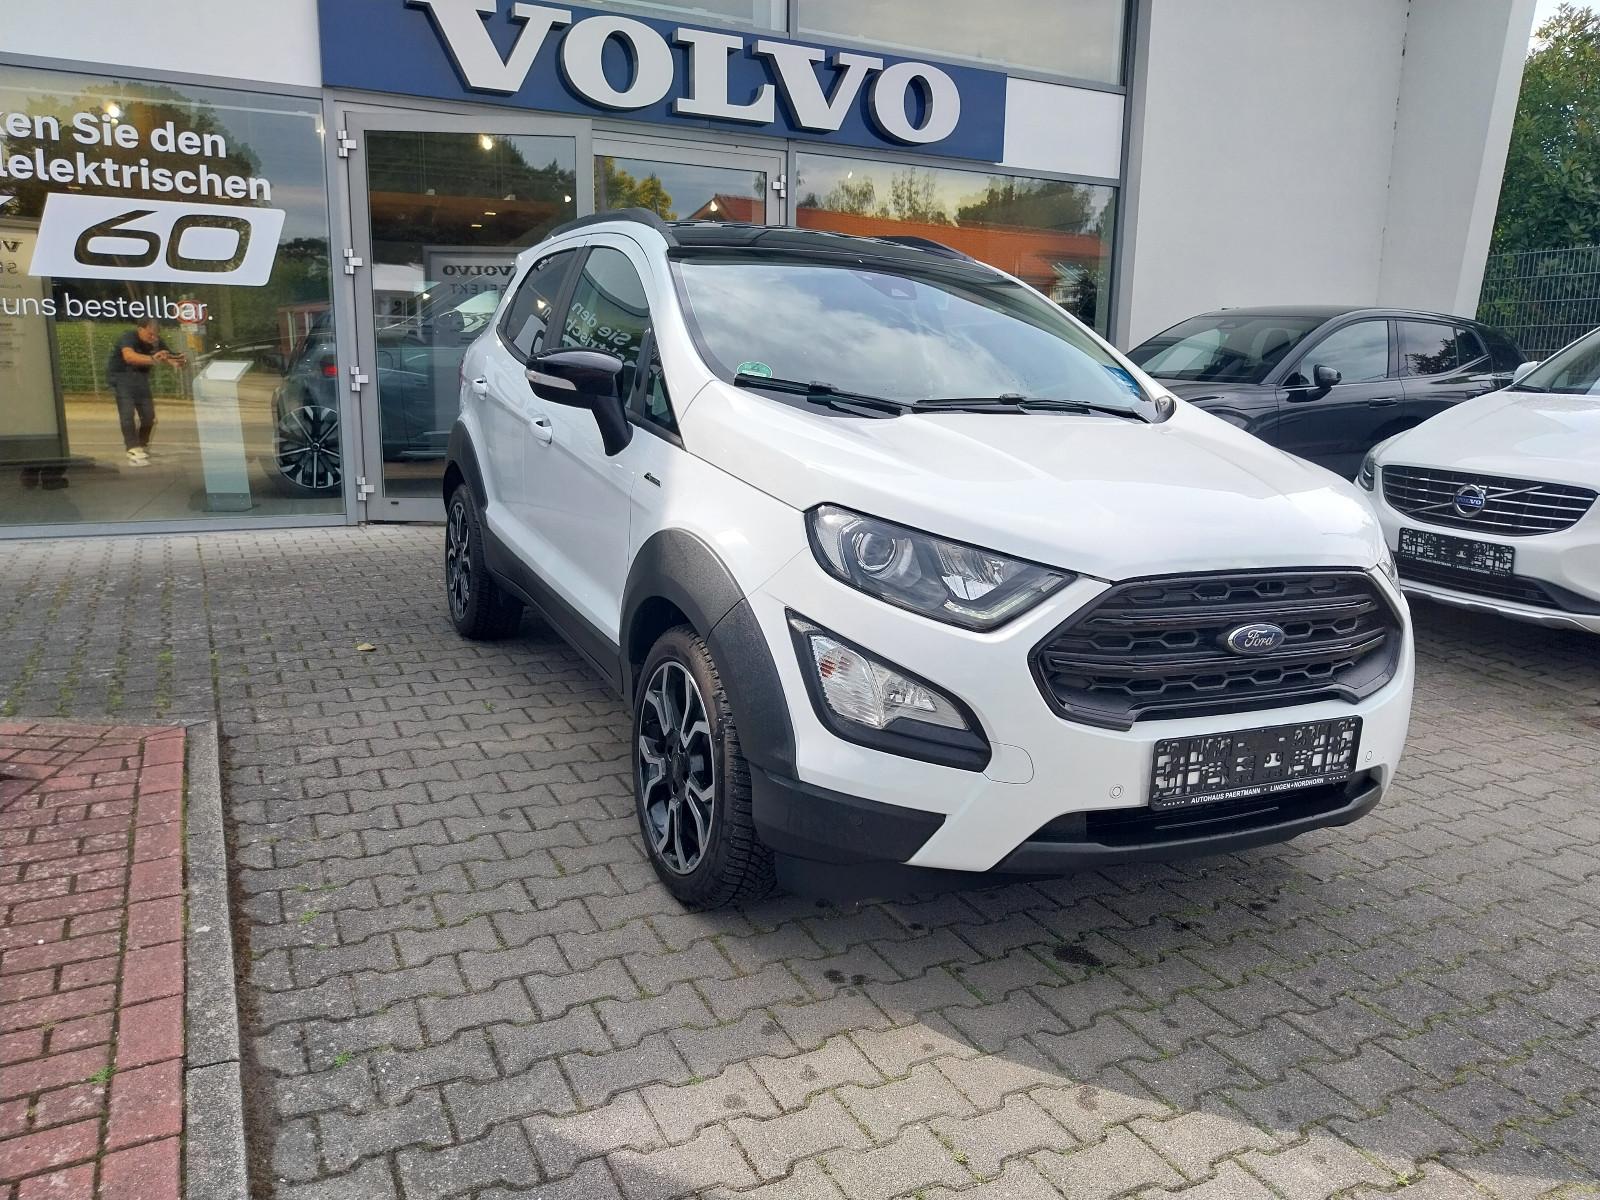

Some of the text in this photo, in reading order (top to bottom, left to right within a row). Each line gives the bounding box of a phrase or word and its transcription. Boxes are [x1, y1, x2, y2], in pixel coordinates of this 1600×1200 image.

[408, 0, 961, 145] VOLVO
[72, 112, 139, 148] Sie
[150, 121, 227, 158] den
[74, 209, 252, 273] 60
[3, 293, 214, 321] uns bestellbar.
[1244, 629, 1276, 647] Ford
[1191, 793, 1225, 804] AUTOHAUS
[1225, 787, 1261, 799] PAERTMANN
